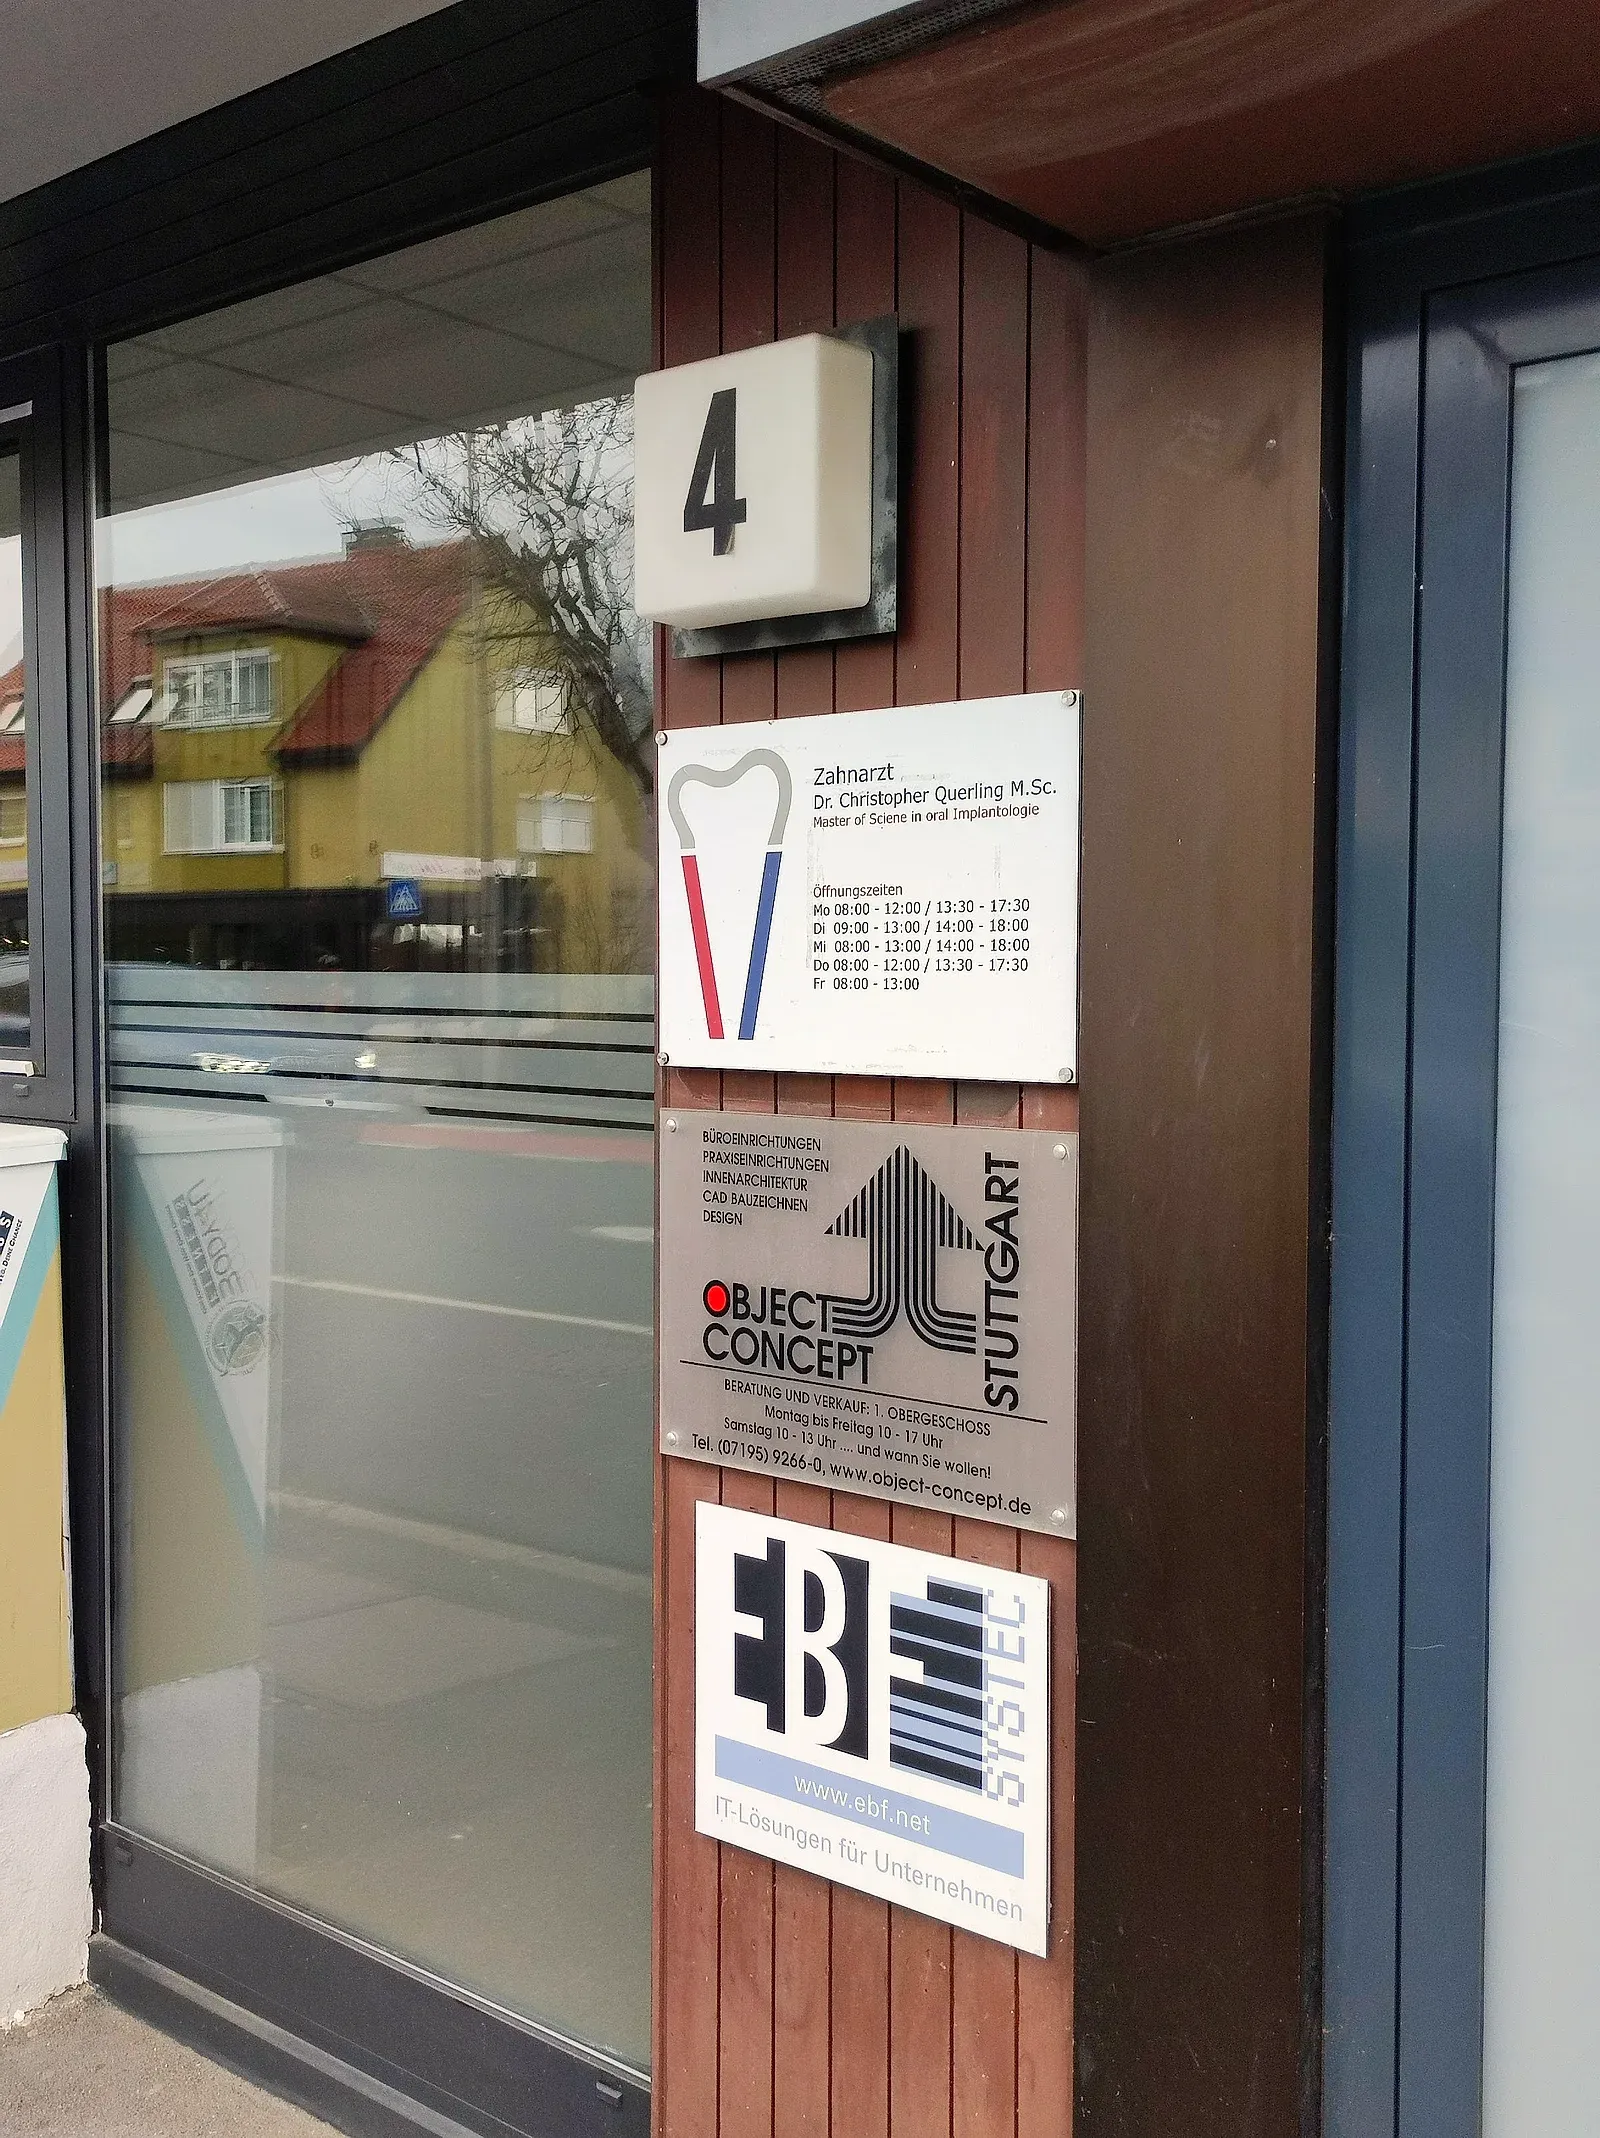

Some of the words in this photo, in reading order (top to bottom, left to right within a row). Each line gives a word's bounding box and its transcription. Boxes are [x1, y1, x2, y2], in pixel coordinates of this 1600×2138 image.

[683, 387, 747, 556] 4
[813, 763, 895, 785] Zahnarzt
[814, 794, 833, 809] Dr.
[839, 788, 929, 808] Christopher
[935, 782, 1003, 802] Querling
[1011, 778, 1057, 796] M.Sc.
[813, 816, 851, 828] Master
[854, 813, 866, 825] of
[869, 811, 907, 824] Sciene
[911, 811, 922, 822] in
[926, 808, 948, 821] oral
[953, 802, 1040, 821] Implantologie
[813, 884, 903, 899] Öffnungszeiten
[813, 904, 830, 916] Mo
[834, 903, 870, 916] 08:00
[884, 902, 921, 915] 12:00
[924, 900, 931, 916] /
[936, 900, 974, 914] 13:30
[990, 898, 1030, 912] 17:30
[813, 923, 825, 935] Di
[833, 922, 869, 934] 09:00
[883, 921, 920, 934] 13:00
[924, 919, 930, 935] /
[935, 919, 974, 933] 14:00
[989, 918, 1029, 932] 18:00
[813, 940, 826, 953] Mi
[834, 940, 870, 953] 08:00
[884, 939, 921, 952] 13:00
[924, 939, 931, 954] /
[936, 939, 974, 952] 14:00
[990, 938, 1030, 952] 18:00
[813, 959, 830, 971] Do
[833, 959, 869, 972] 08:00
[883, 958, 920, 972] 12:00
[923, 958, 930, 973] /
[935, 958, 973, 972] 13:30
[989, 958, 1028, 971] 17:30
[813, 978, 825, 990] Fr
[833, 977, 869, 990] 08:00
[883, 977, 920, 990] 13:00
[702, 1128, 821, 1151] BÜROEINRICHTUNGEN
[703, 1151, 829, 1172] PRAXISEINRICHTUNGEN
[703, 1170, 808, 1191] INNENARCHITEKTUR
[702, 1190, 728, 1204] CAD
[731, 1192, 808, 1212] BAUZEICHNEN
[703, 1210, 742, 1225] DESIGN
[984, 1152, 1020, 1411] STUTTGART
[703, 1280, 833, 1332] OBJECT
[703, 1323, 874, 1384] CONCEPT
[724, 1378, 782, 1399] BERATUNG
[786, 1389, 810, 1404] UND
[813, 1393, 870, 1415] VERKAUF:
[874, 1403, 884, 1418] 1.
[888, 1406, 991, 1436] OBERGESCHOSS
[764, 1404, 810, 1427] Montag
[812, 1412, 829, 1427] bis
[832, 1417, 874, 1438] Freitag
[878, 1424, 891, 1439] 10
[905, 1429, 918, 1444] 17
[922, 1432, 944, 1449] Uhr
[724, 1417, 772, 1440] Samstag
[776, 1426, 788, 1440] 10
[801, 1431, 814, 1445] 13
[817, 1433, 836, 1449] Uhr
[857, 1443, 880, 1457] und
[884, 1449, 919, 1465] wann
[922, 1453, 941, 1469] Sie
[945, 1460, 991, 1480] wollen!
[692, 1433, 714, 1451] Tel.
[718, 1438, 769, 1464] (07195)
[773, 1449, 826, 1476] 9266-0,
[830, 1462, 1032, 1515] www.object-concept.de
[983, 1588, 1025, 1808] SYSTEC
[793, 1775, 931, 1836] www.ebf.net
[715, 1795, 832, 1854] IT-Lösungen
[839, 1838, 868, 1866] für
[874, 1849, 1023, 1922] Unternehmen
